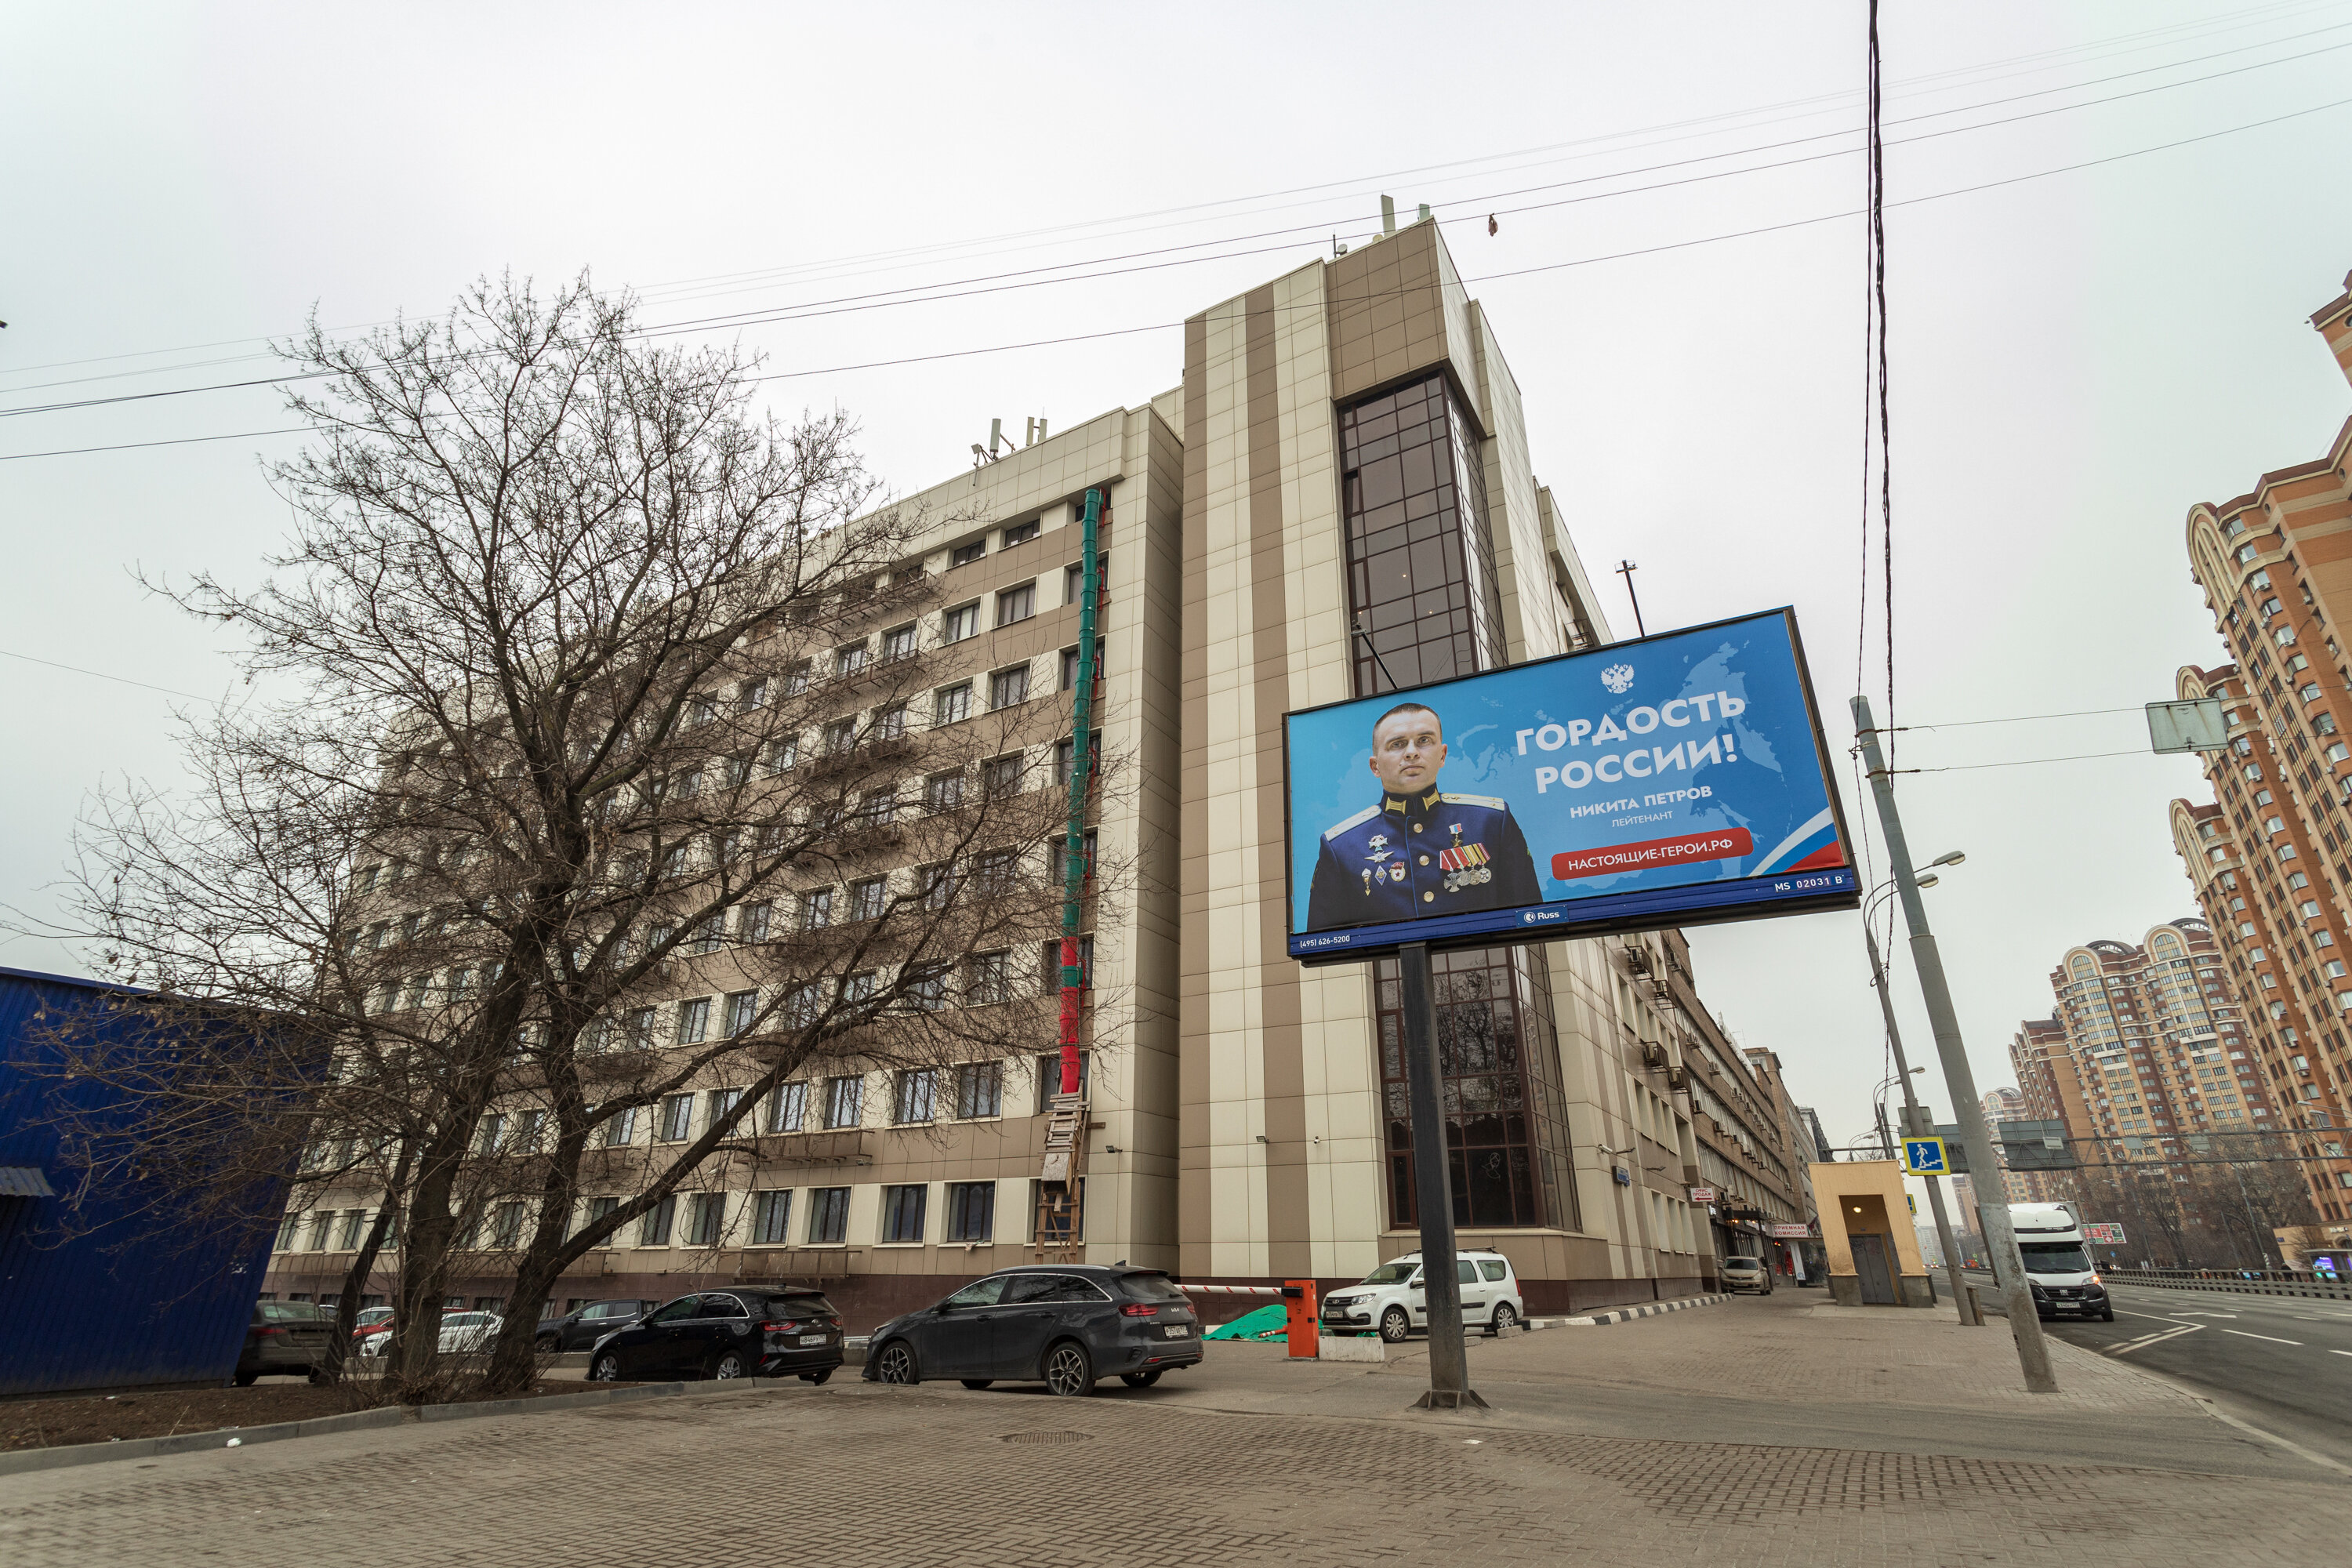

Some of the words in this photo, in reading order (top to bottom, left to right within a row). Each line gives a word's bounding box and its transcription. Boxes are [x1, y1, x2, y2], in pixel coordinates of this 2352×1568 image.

[1515, 691, 1746, 756] ГОРДОСТЬ
[1535, 734, 1737, 794] РОССИИ!
[1570, 797, 1639, 818] НИКИТА
[1644, 786, 1712, 807] ПЕТРОВ
[1612, 811, 1673, 827] ЛЕЙТЕНАНТ
[1568, 838, 1733, 871] НАСТОЯЩИЕ-ГЕРОИ.РФ
[1774, 882, 1791, 892] MS
[1796, 877, 1830, 888] 02031
[1537, 912, 1559, 920] Russ
[1300, 939, 1316, 949] (495)
[1318, 935, 1350, 946] 626-5200
